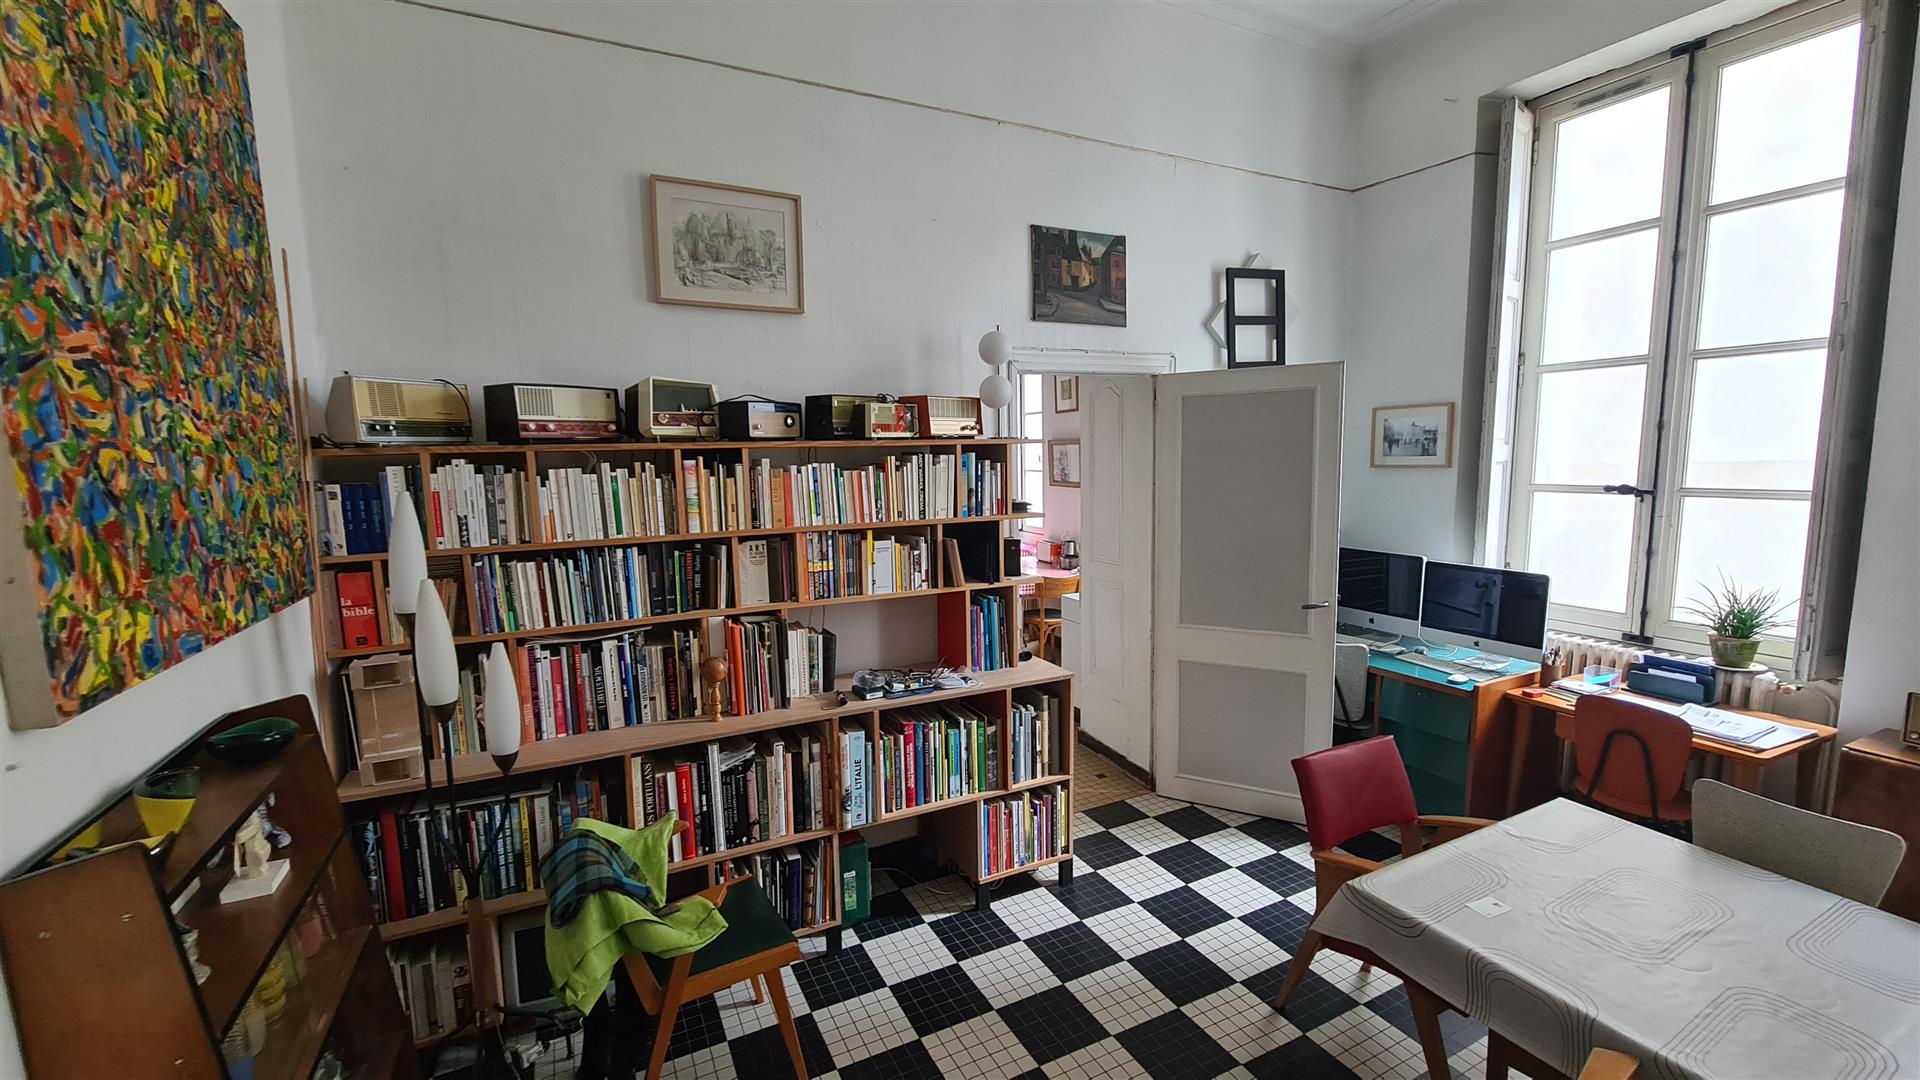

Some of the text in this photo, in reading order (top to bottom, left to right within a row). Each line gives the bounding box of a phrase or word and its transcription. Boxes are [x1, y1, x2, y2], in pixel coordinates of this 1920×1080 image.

[749, 544, 765, 552] ART
[341, 598, 352, 606] la
[342, 607, 374, 617] bible
[854, 759, 862, 790] L'ITALIE
[641, 762, 654, 813] PORTULANS
